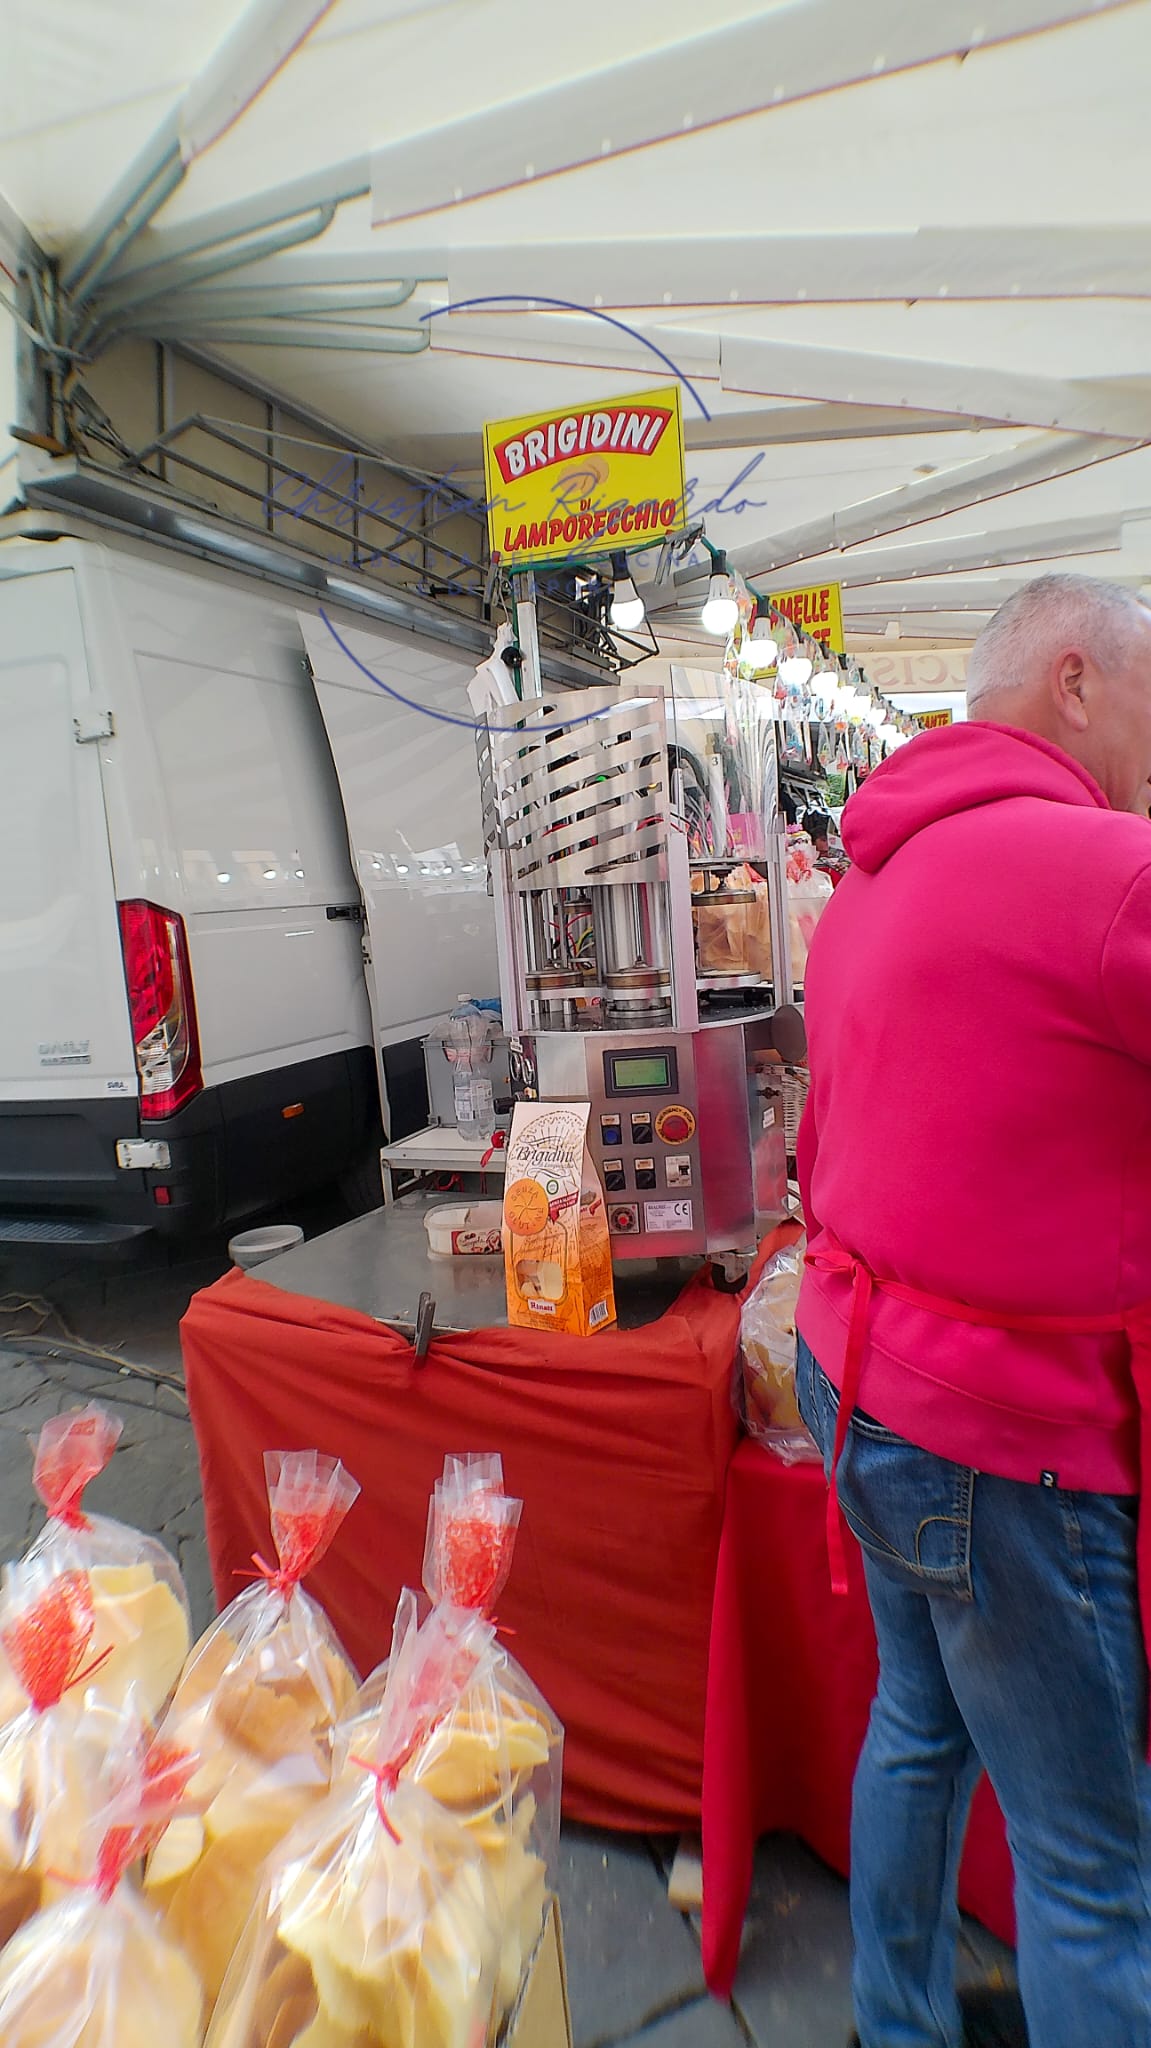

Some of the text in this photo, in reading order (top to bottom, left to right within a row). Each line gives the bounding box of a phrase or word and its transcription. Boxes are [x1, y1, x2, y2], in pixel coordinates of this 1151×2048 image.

[504, 411, 664, 476] BRIGIDINI
[503, 498, 676, 552] LAMPORECCHIO
[579, 498, 592, 512] DI
[748, 589, 830, 635] AMELLE
[515, 1144, 574, 1166] Brigidini
